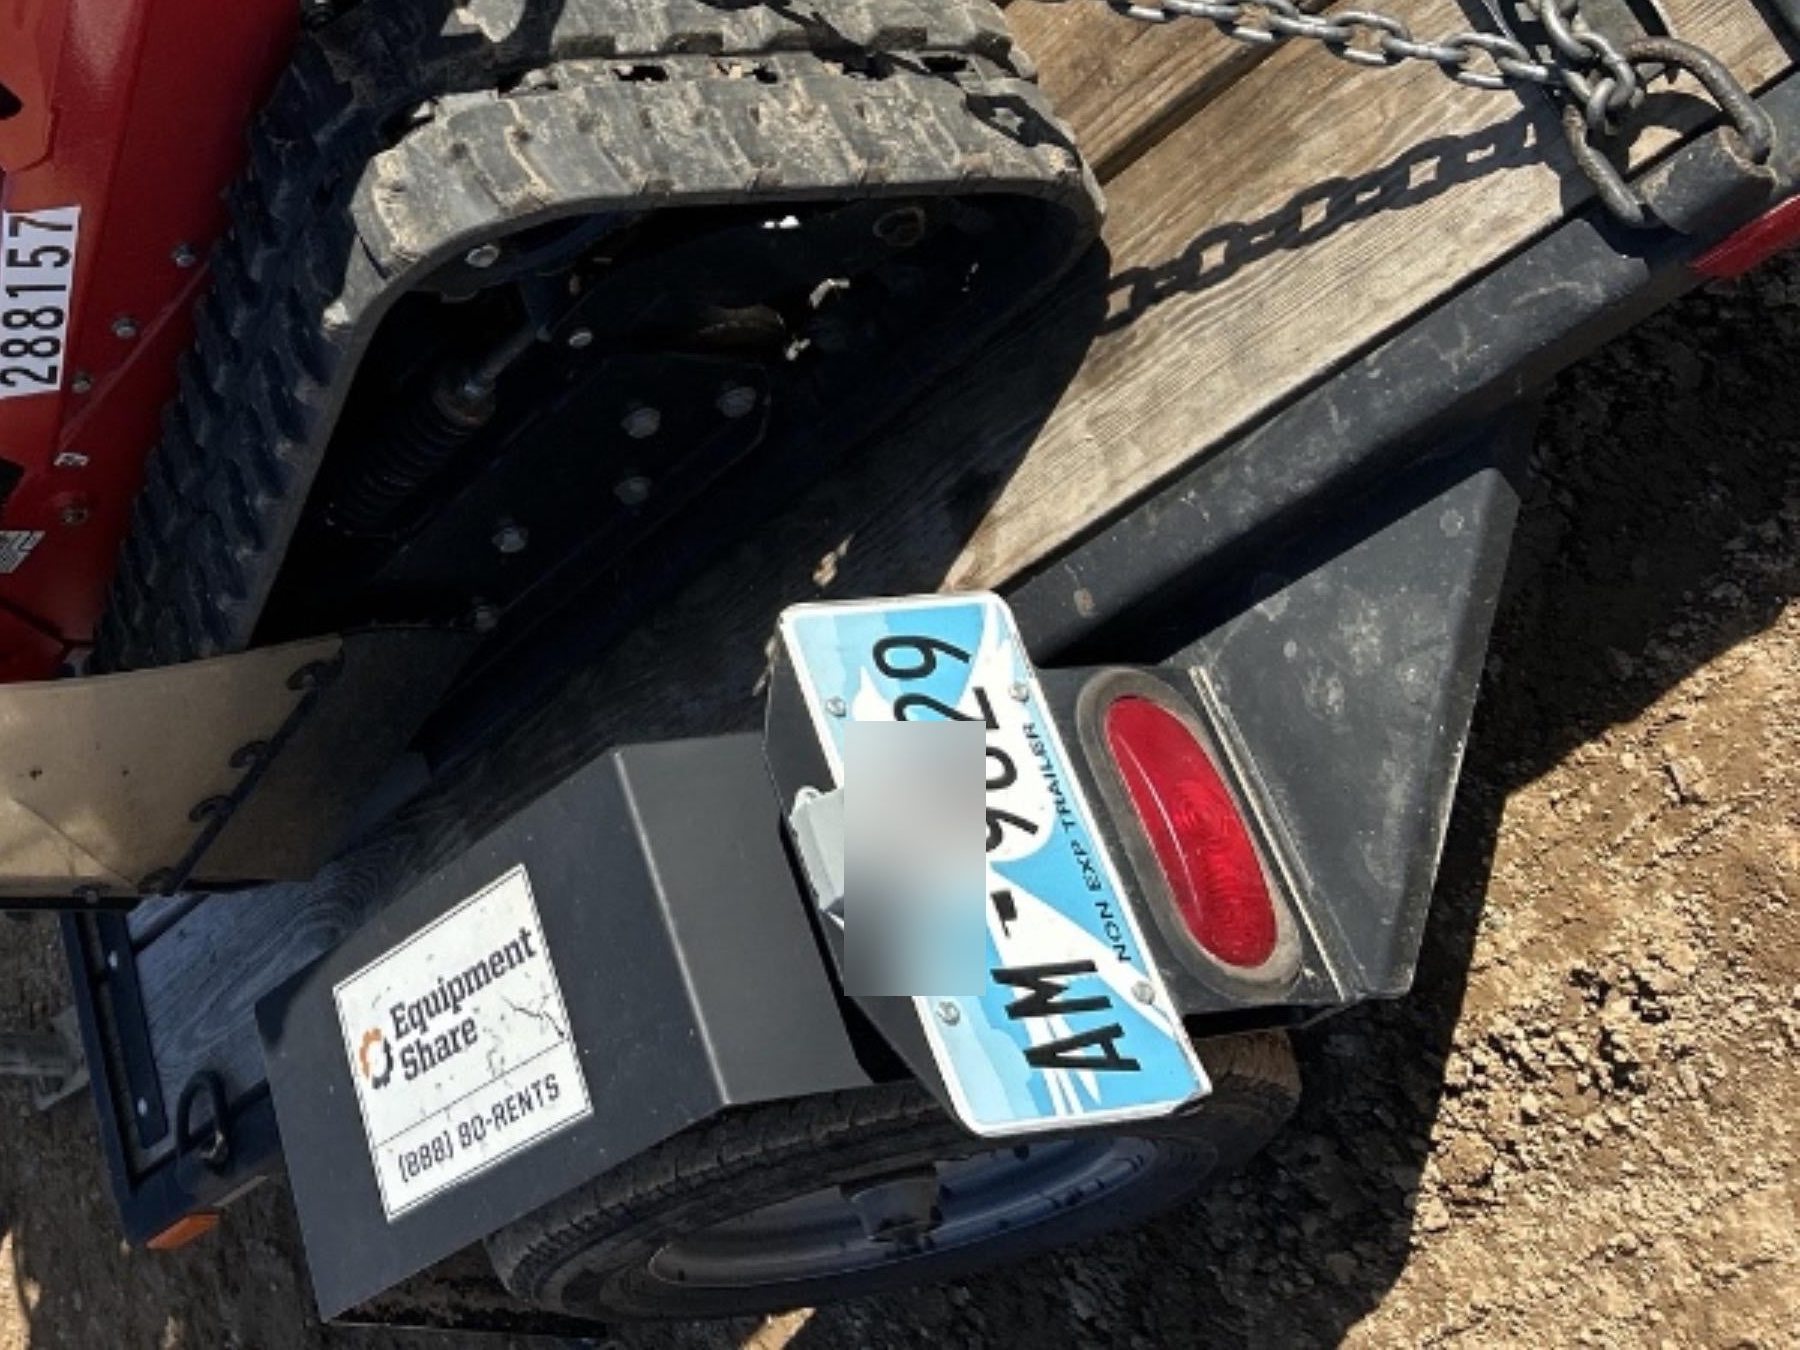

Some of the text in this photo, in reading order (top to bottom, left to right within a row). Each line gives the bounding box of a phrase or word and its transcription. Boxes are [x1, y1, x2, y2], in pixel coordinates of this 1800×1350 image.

[1021, 721, 1132, 962] NON EXP TRAILER
[390, 926, 536, 1040] Equipment
[990, 959, 1140, 1072] AM
[400, 1016, 478, 1080] Share
[398, 1073, 560, 1183] (888) 80-RENTS
